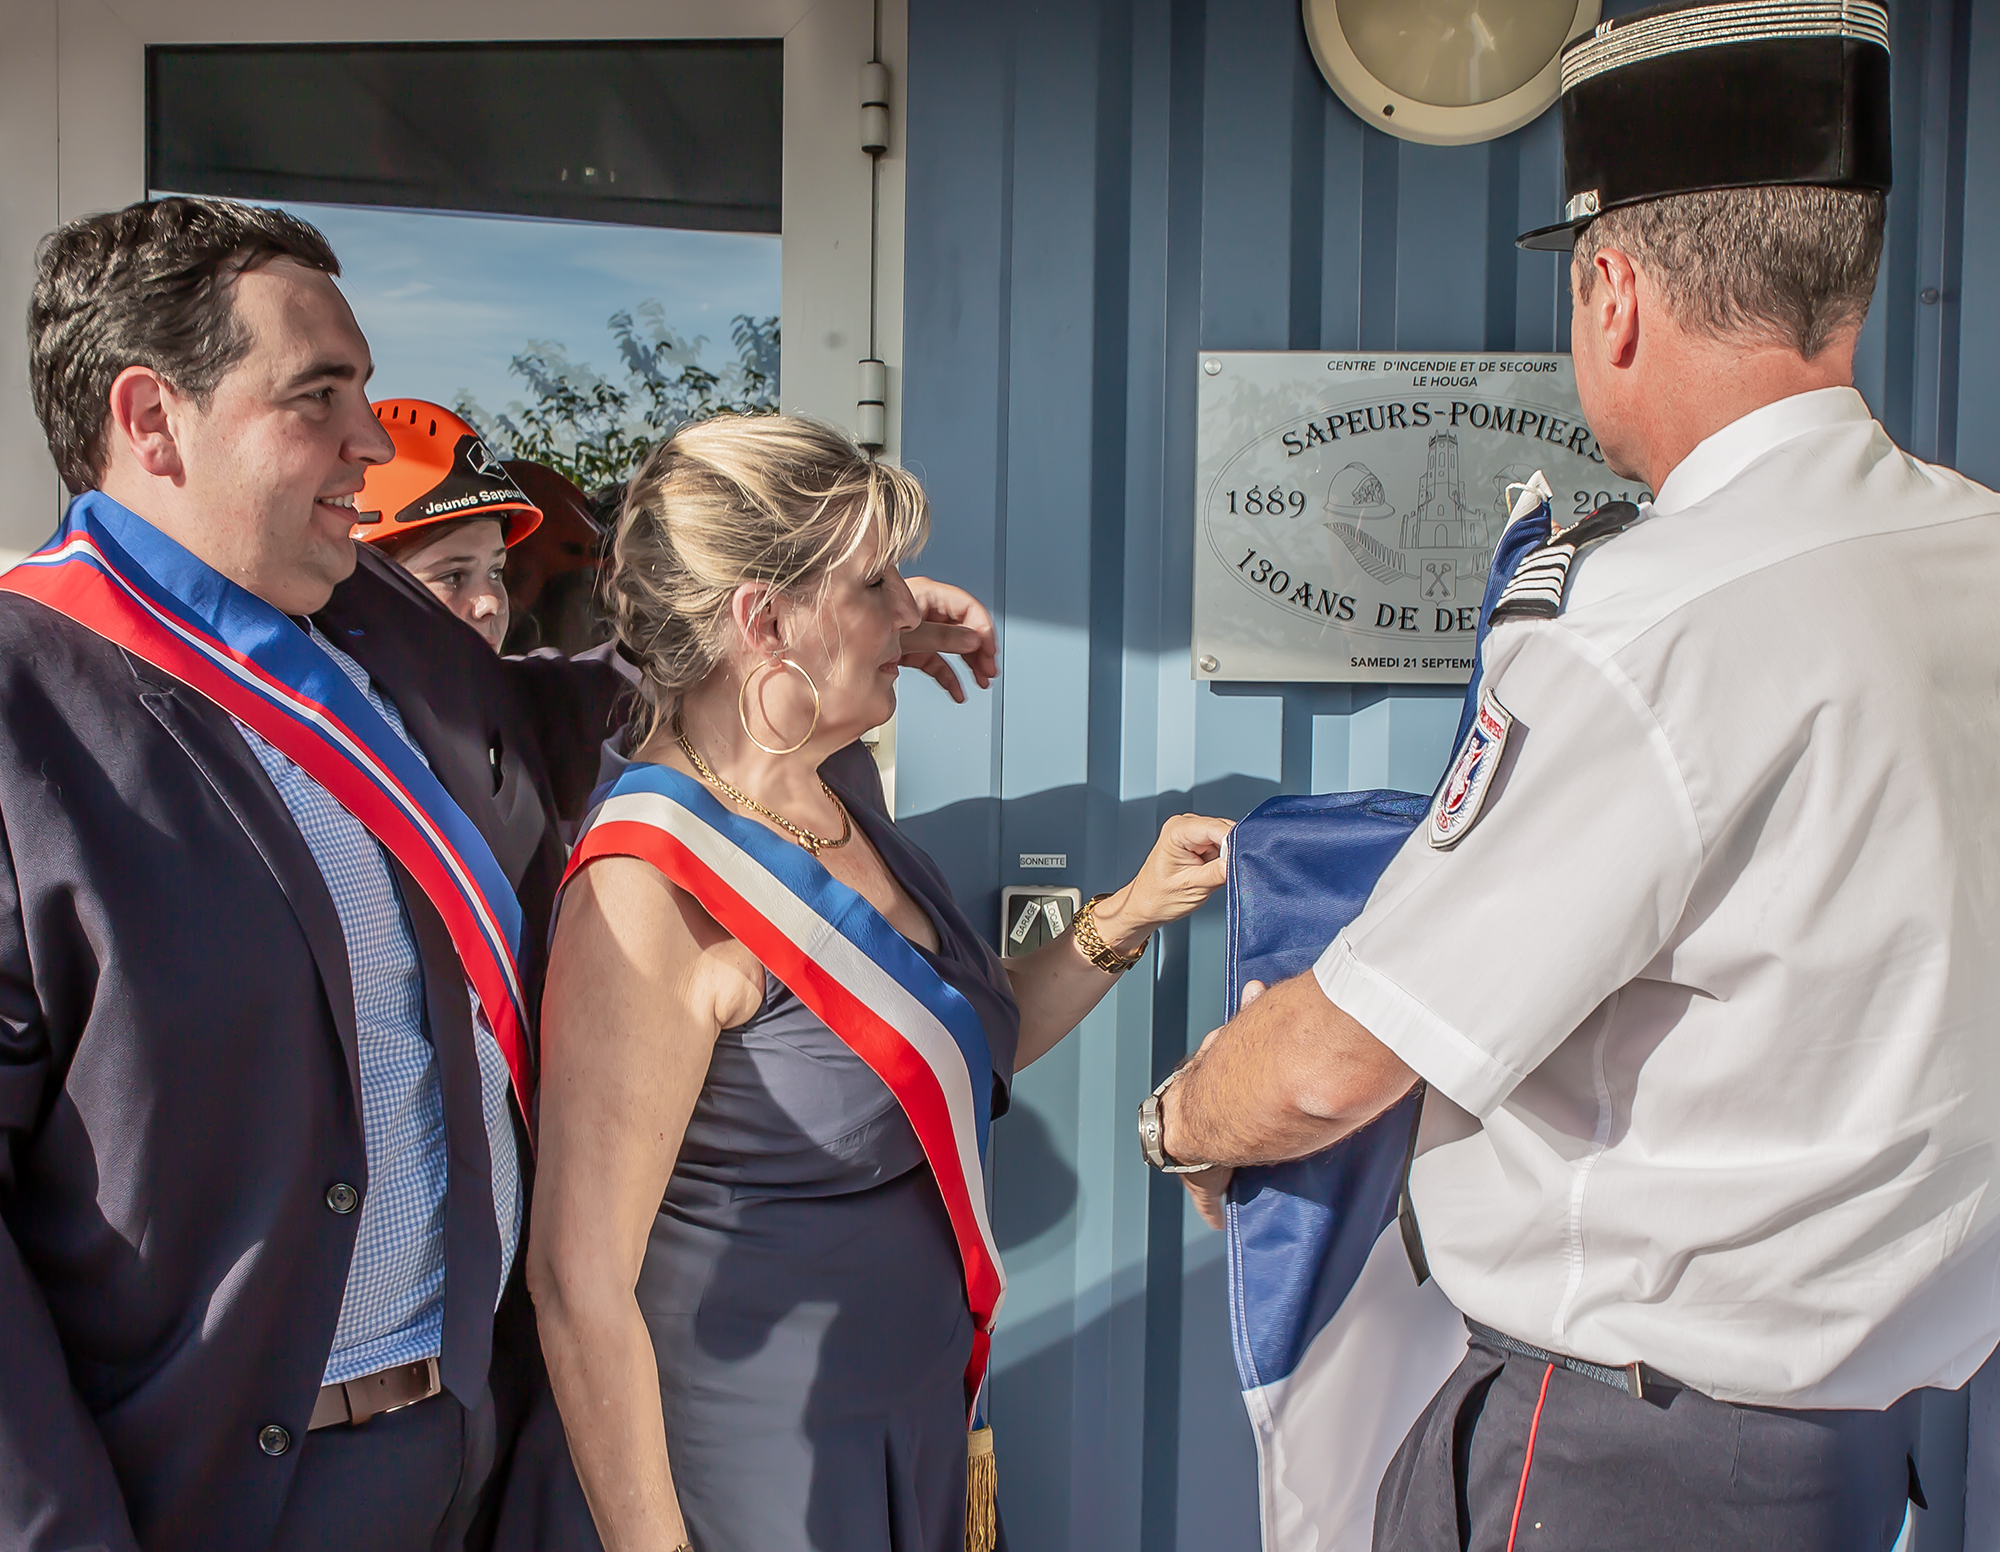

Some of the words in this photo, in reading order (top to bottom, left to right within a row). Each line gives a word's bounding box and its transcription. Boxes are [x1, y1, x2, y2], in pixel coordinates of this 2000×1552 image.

[1326, 360, 1377, 372] CENTRE
[1383, 360, 1457, 373] D'INCENDIE
[1459, 361, 1476, 373] ET
[1478, 361, 1496, 373] DE
[1499, 361, 1558, 373] SECOURS
[1412, 376, 1427, 387] LE
[1430, 376, 1478, 388] HOUGA
[426, 495, 478, 515] Jeunes
[1225, 484, 1307, 519] 1889
[1236, 547, 1291, 595] 130
[1287, 581, 1357, 621] ANS
[1374, 602, 1420, 632] DE
[1350, 657, 1400, 668] SAMEDI
[1403, 658, 1417, 668] 21
[1020, 857, 1066, 866] SONNETTE
[1015, 903, 1038, 937] GARAGE
